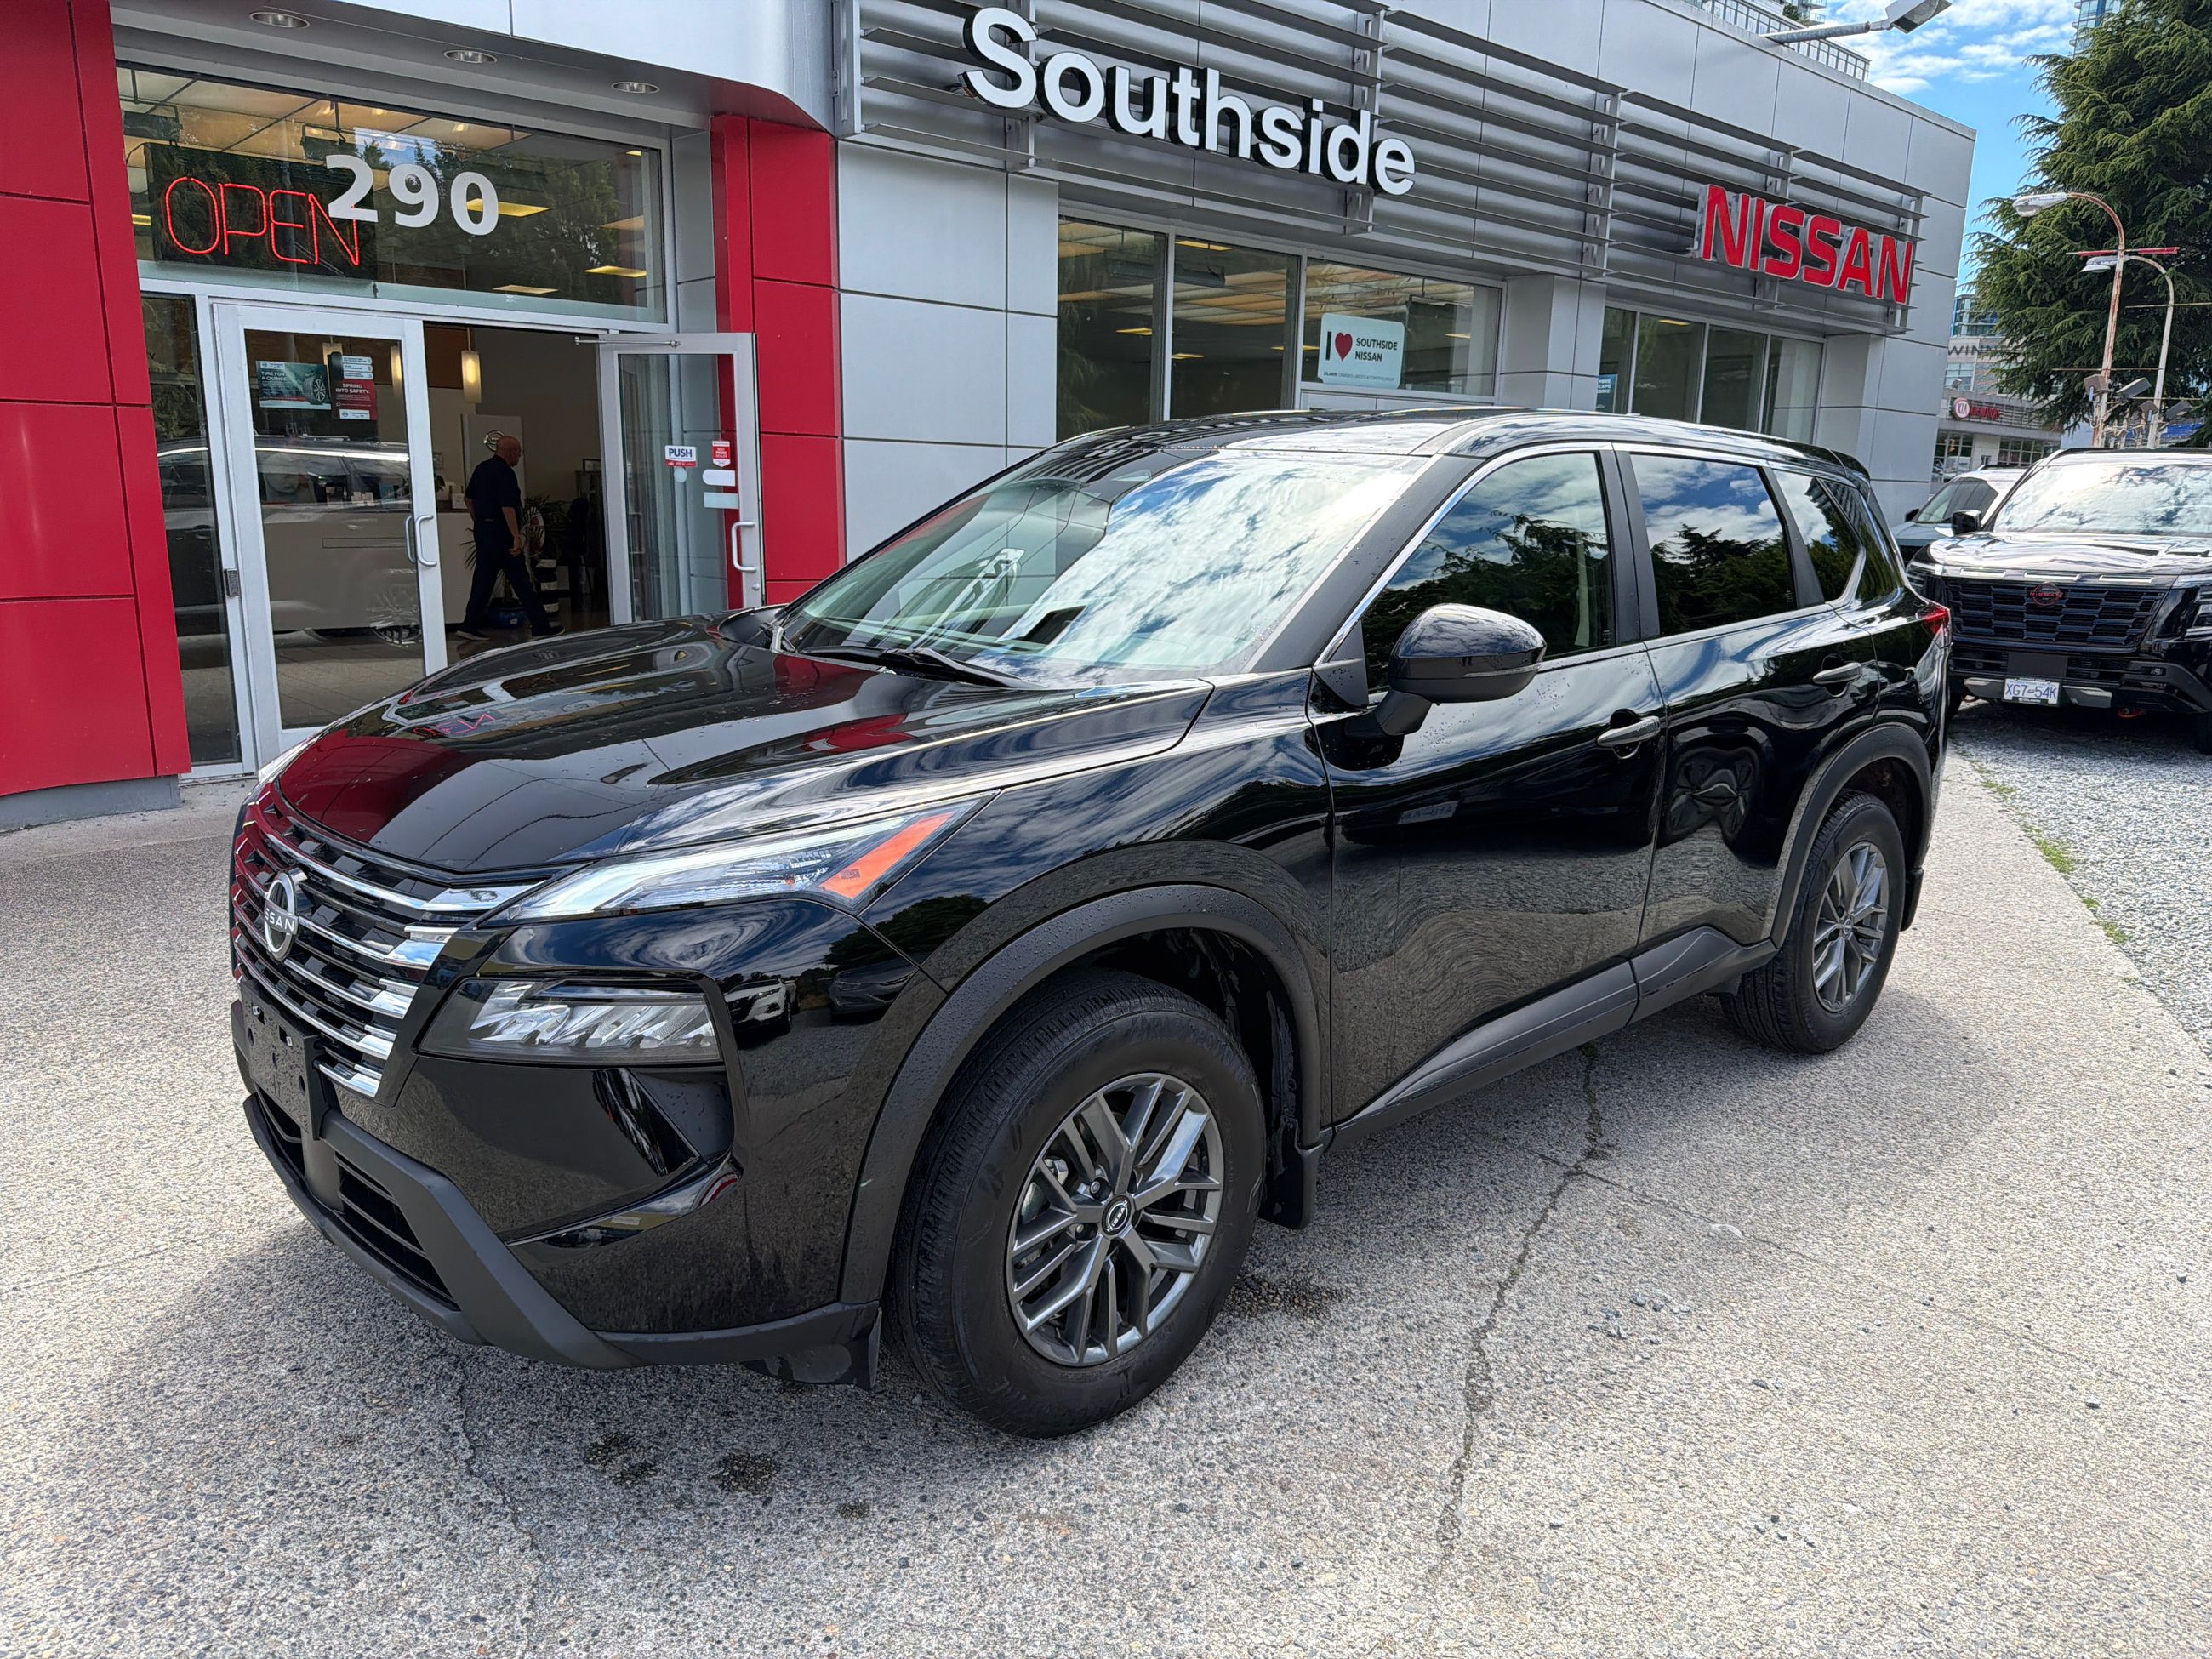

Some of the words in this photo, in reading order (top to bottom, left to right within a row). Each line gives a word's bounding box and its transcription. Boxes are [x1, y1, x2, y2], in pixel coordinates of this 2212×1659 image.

[963, 6, 1417, 196] Southside
[164, 176, 360, 266] OPEN
[325, 153, 499, 237] 290
[1700, 184, 1915, 305] NISSAN
[1325, 330, 1332, 361] I
[1355, 337, 1398, 351] SOUTHSIDE
[1354, 351, 1383, 362] NISSAN
[668, 448, 693, 458] PUSH
